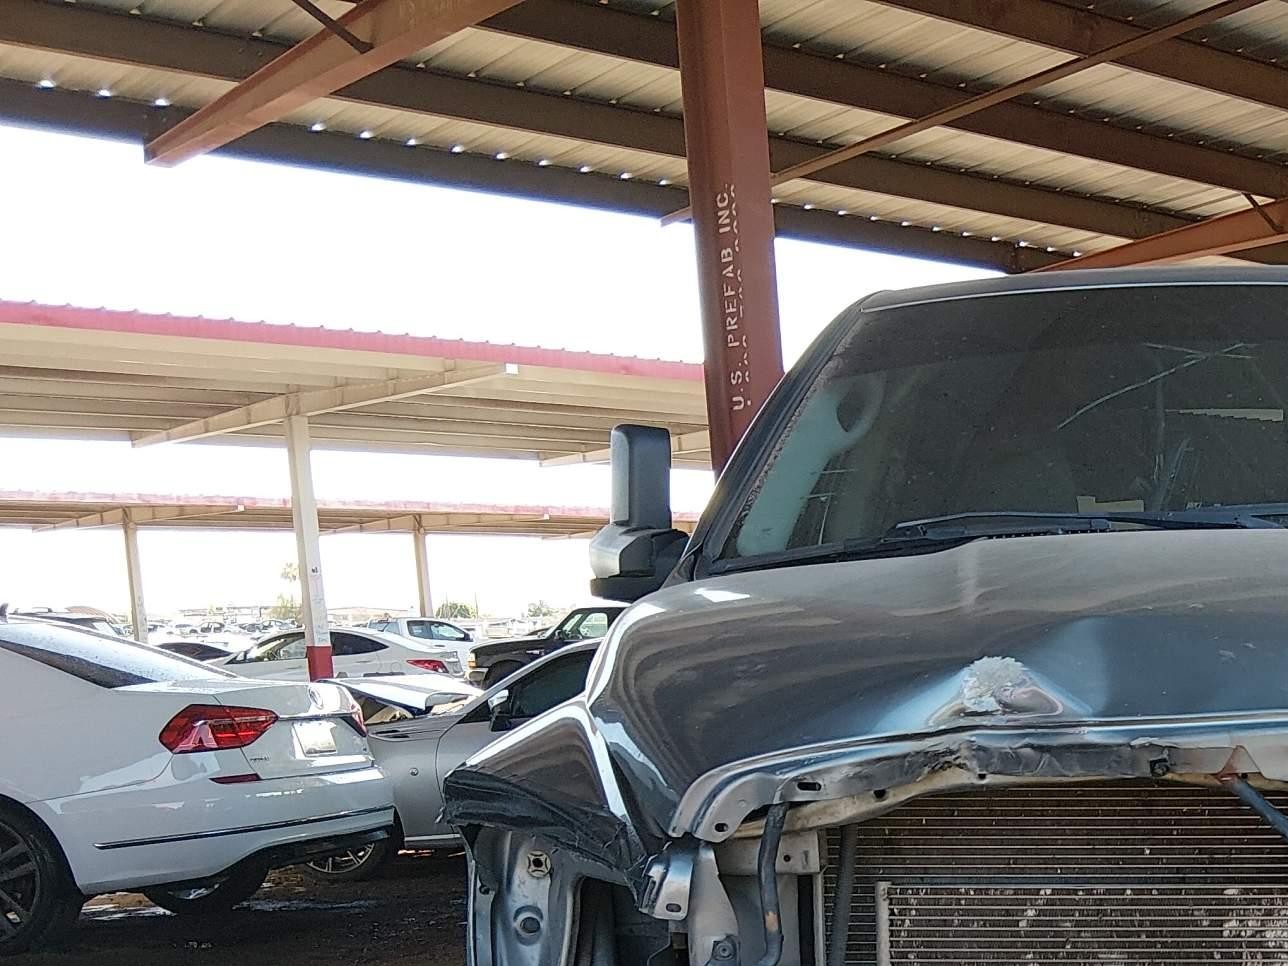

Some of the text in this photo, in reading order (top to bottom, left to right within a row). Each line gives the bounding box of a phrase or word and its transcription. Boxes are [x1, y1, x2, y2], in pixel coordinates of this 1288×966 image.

[716, 183, 732, 234] INC.
[720, 247, 740, 347] PREFAB
[730, 362, 745, 411] U.S.
